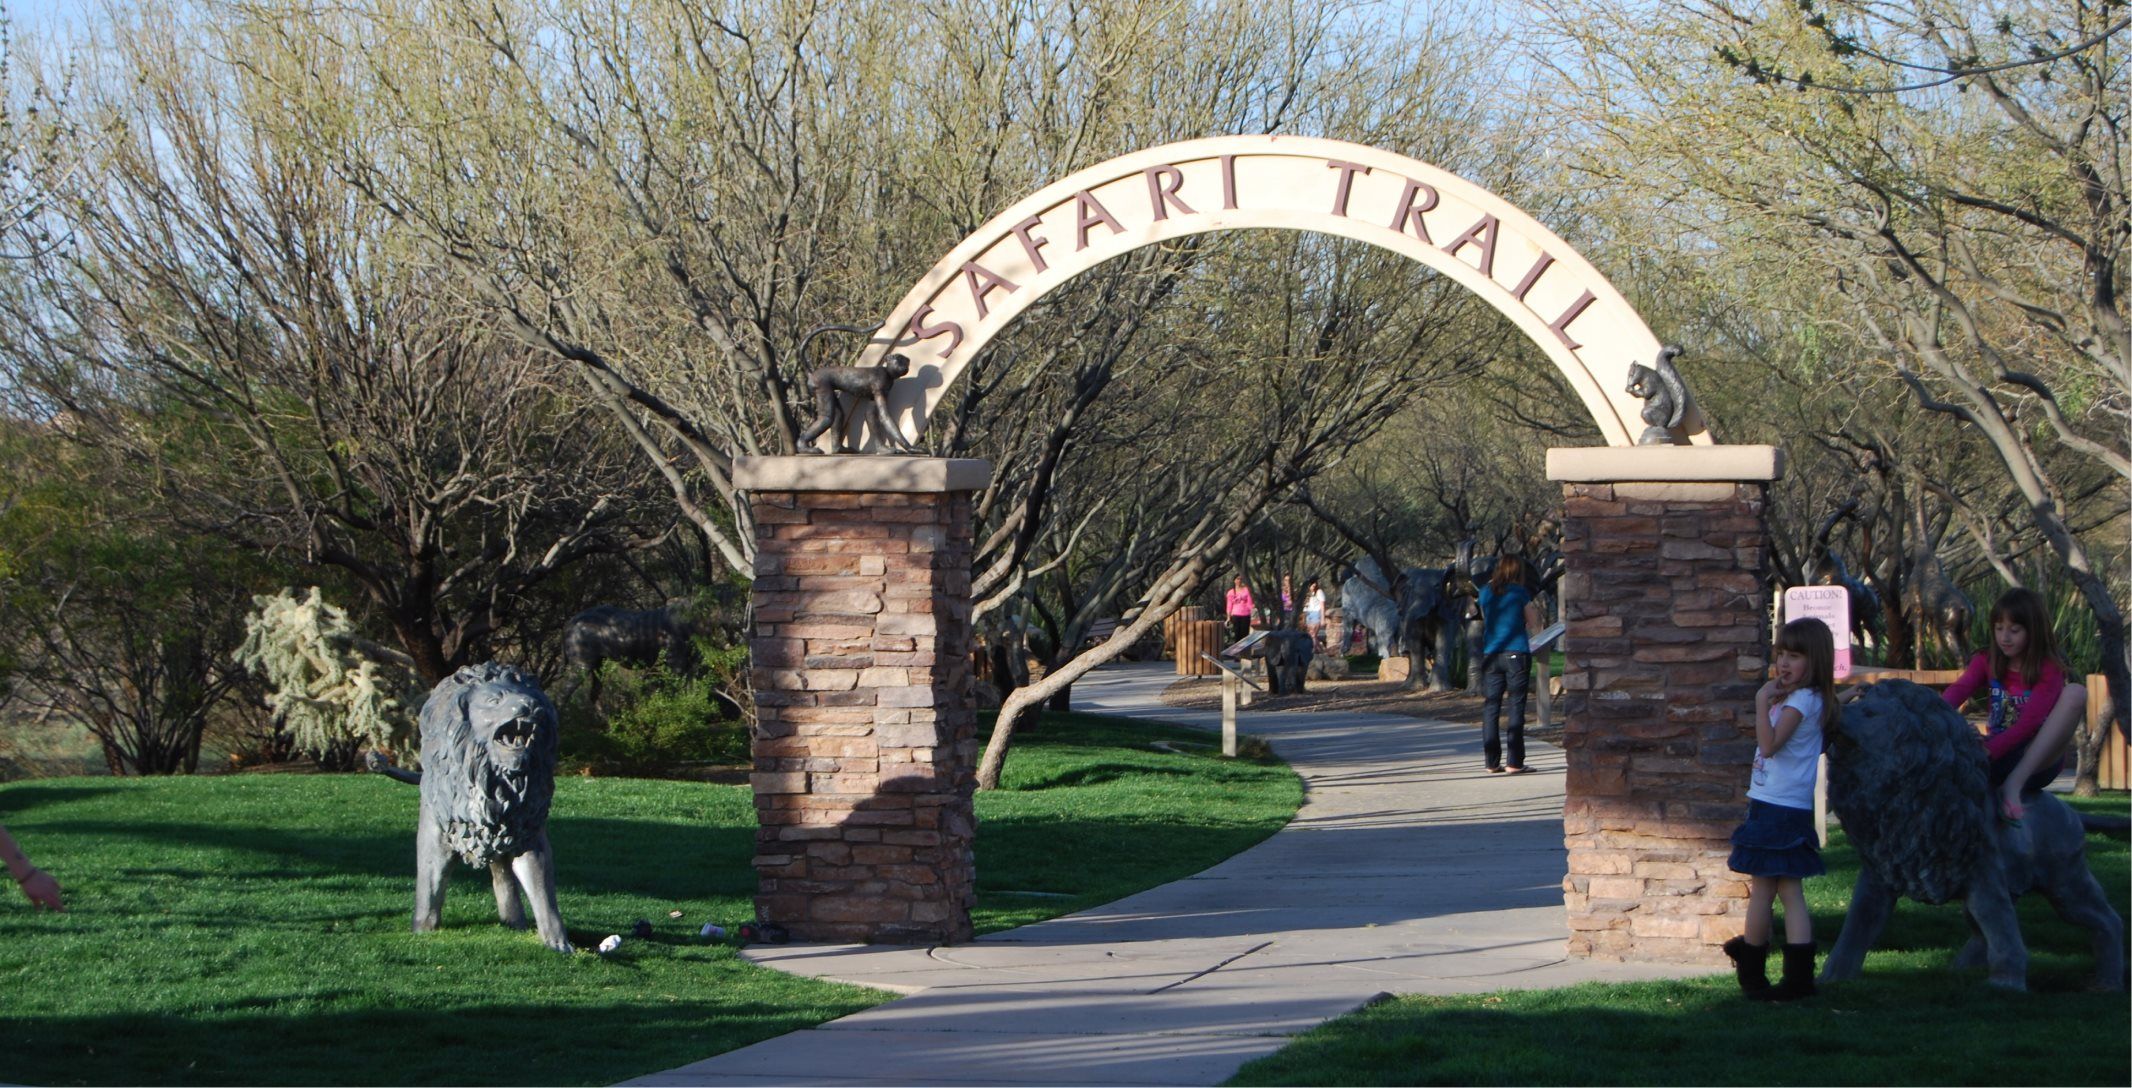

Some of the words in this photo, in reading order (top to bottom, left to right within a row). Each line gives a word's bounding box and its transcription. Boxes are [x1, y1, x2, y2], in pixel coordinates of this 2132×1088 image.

[910, 154, 1239, 359] SAFARI
[1326, 159, 1598, 351] TRAIL
[1789, 589, 1843, 601] CAUTION!
